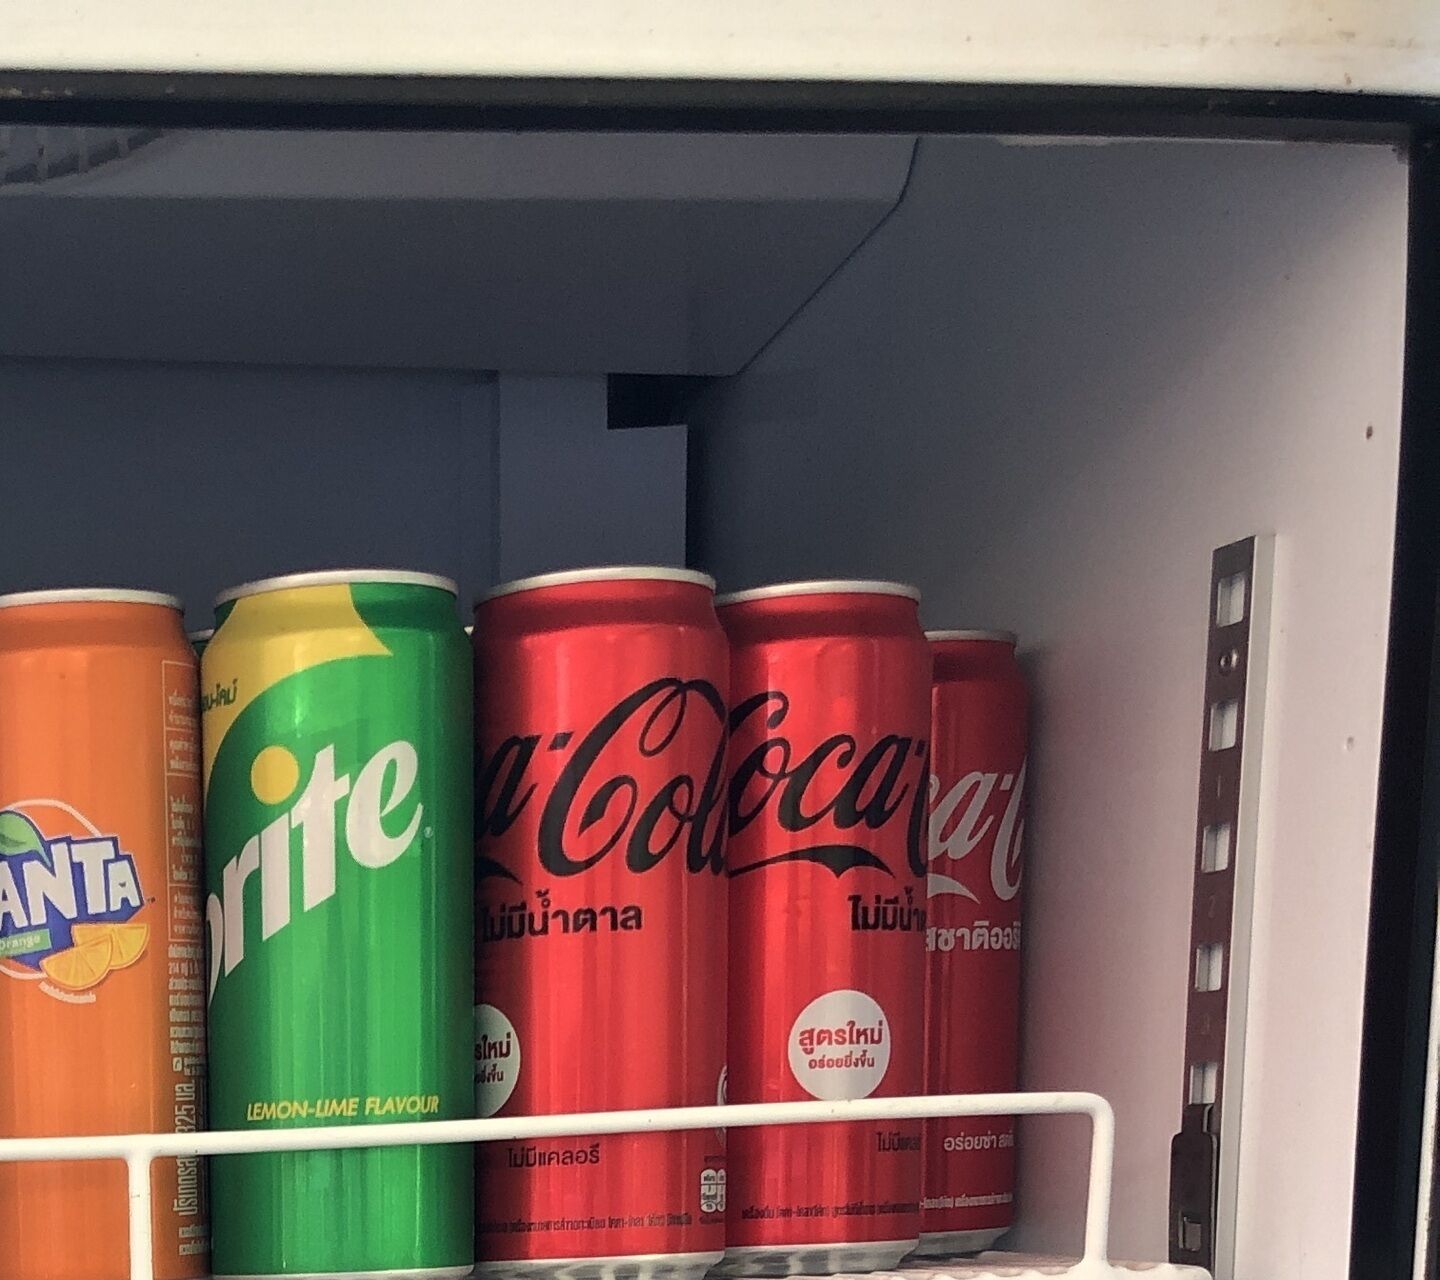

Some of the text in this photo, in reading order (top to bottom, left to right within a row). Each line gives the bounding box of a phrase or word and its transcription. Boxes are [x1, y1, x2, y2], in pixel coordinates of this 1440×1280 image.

[206, 740, 422, 1010] rite
[475, 890, 642, 942] ไม่มีน้ำตาล
[848, 886, 926, 931] ไม่มีน้ำ
[799, 1020, 883, 1055] สูตรใหม่
[808, 1050, 875, 1069] อร่อยยิ่งขึ้น
[247, 1095, 439, 1121] LEMON-LIME FLAVOUR
